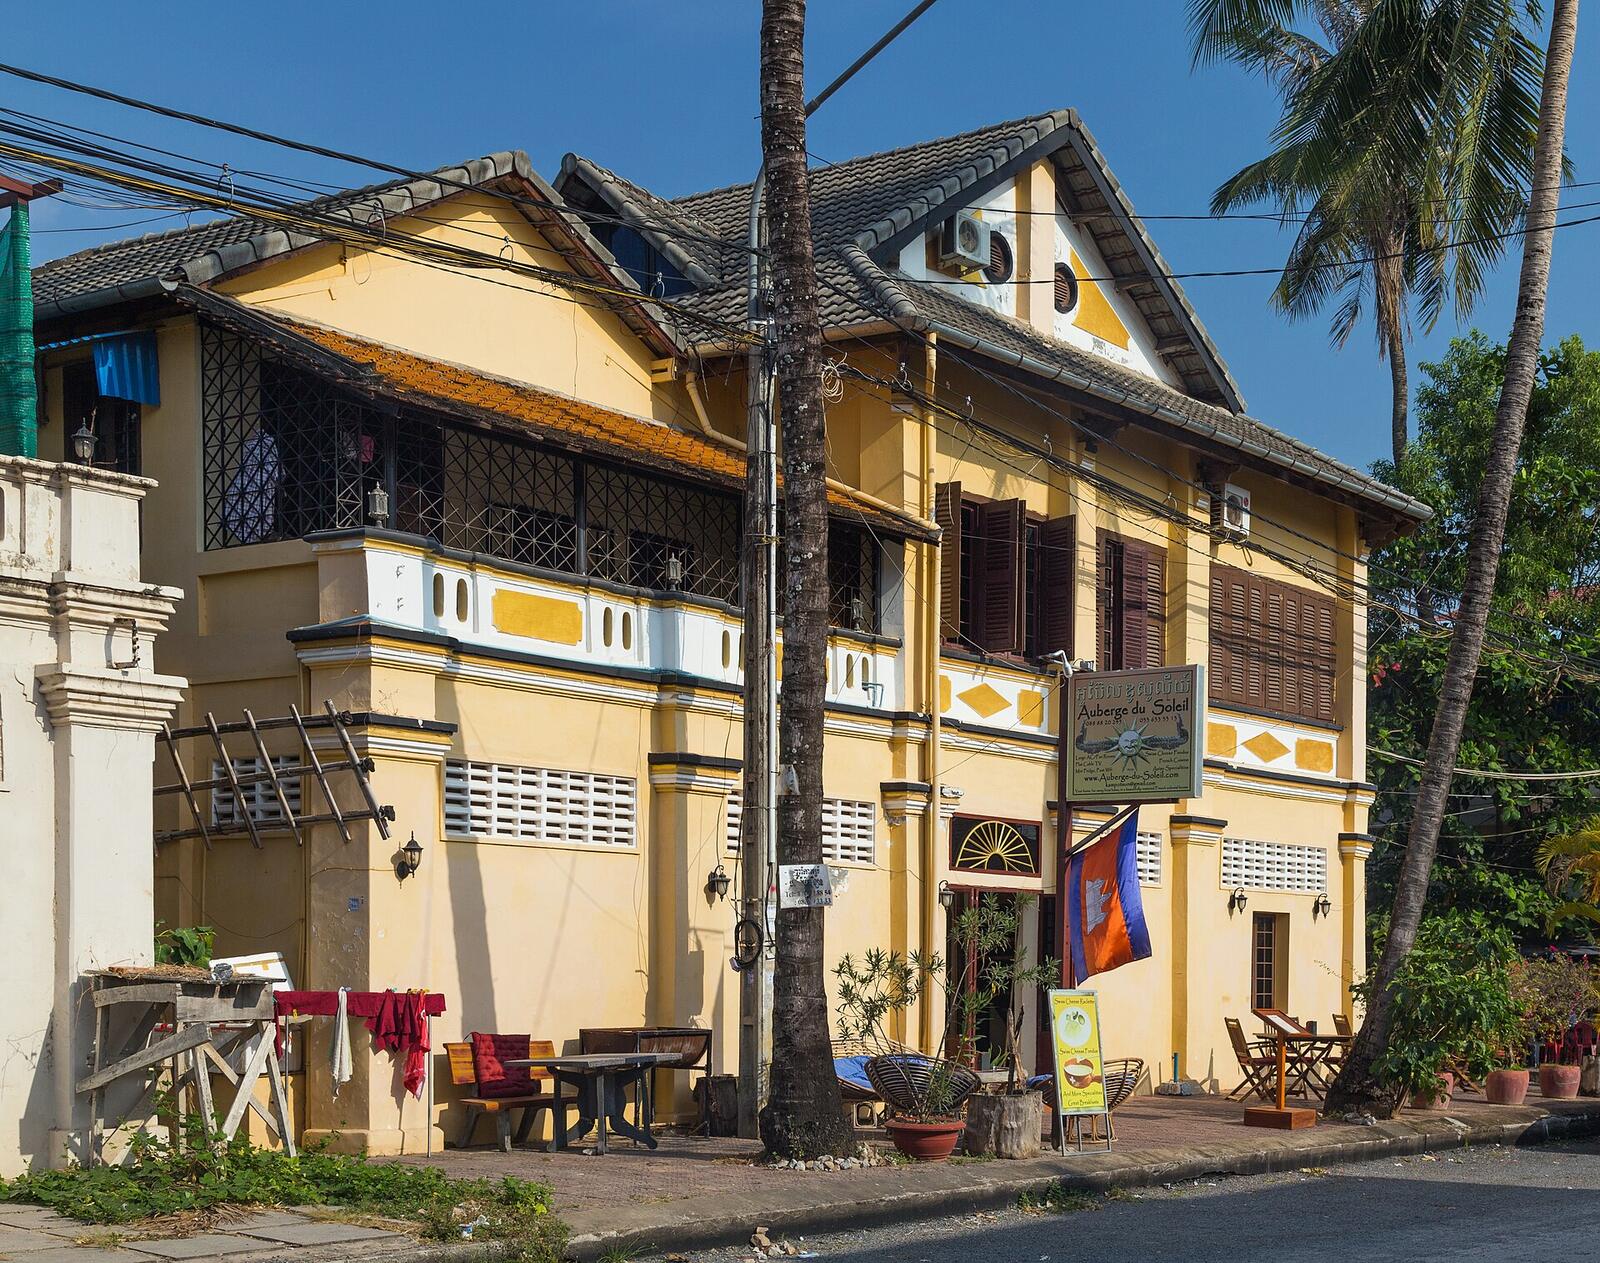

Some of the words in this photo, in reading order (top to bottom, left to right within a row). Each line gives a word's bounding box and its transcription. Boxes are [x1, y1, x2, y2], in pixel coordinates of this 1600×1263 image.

[1077, 703, 1129, 720] Auberge
[1131, 701, 1146, 715] du
[1152, 698, 1189, 716] Soleil
[1084, 770, 1179, 782] www.Auberge-du-Soleil.com
